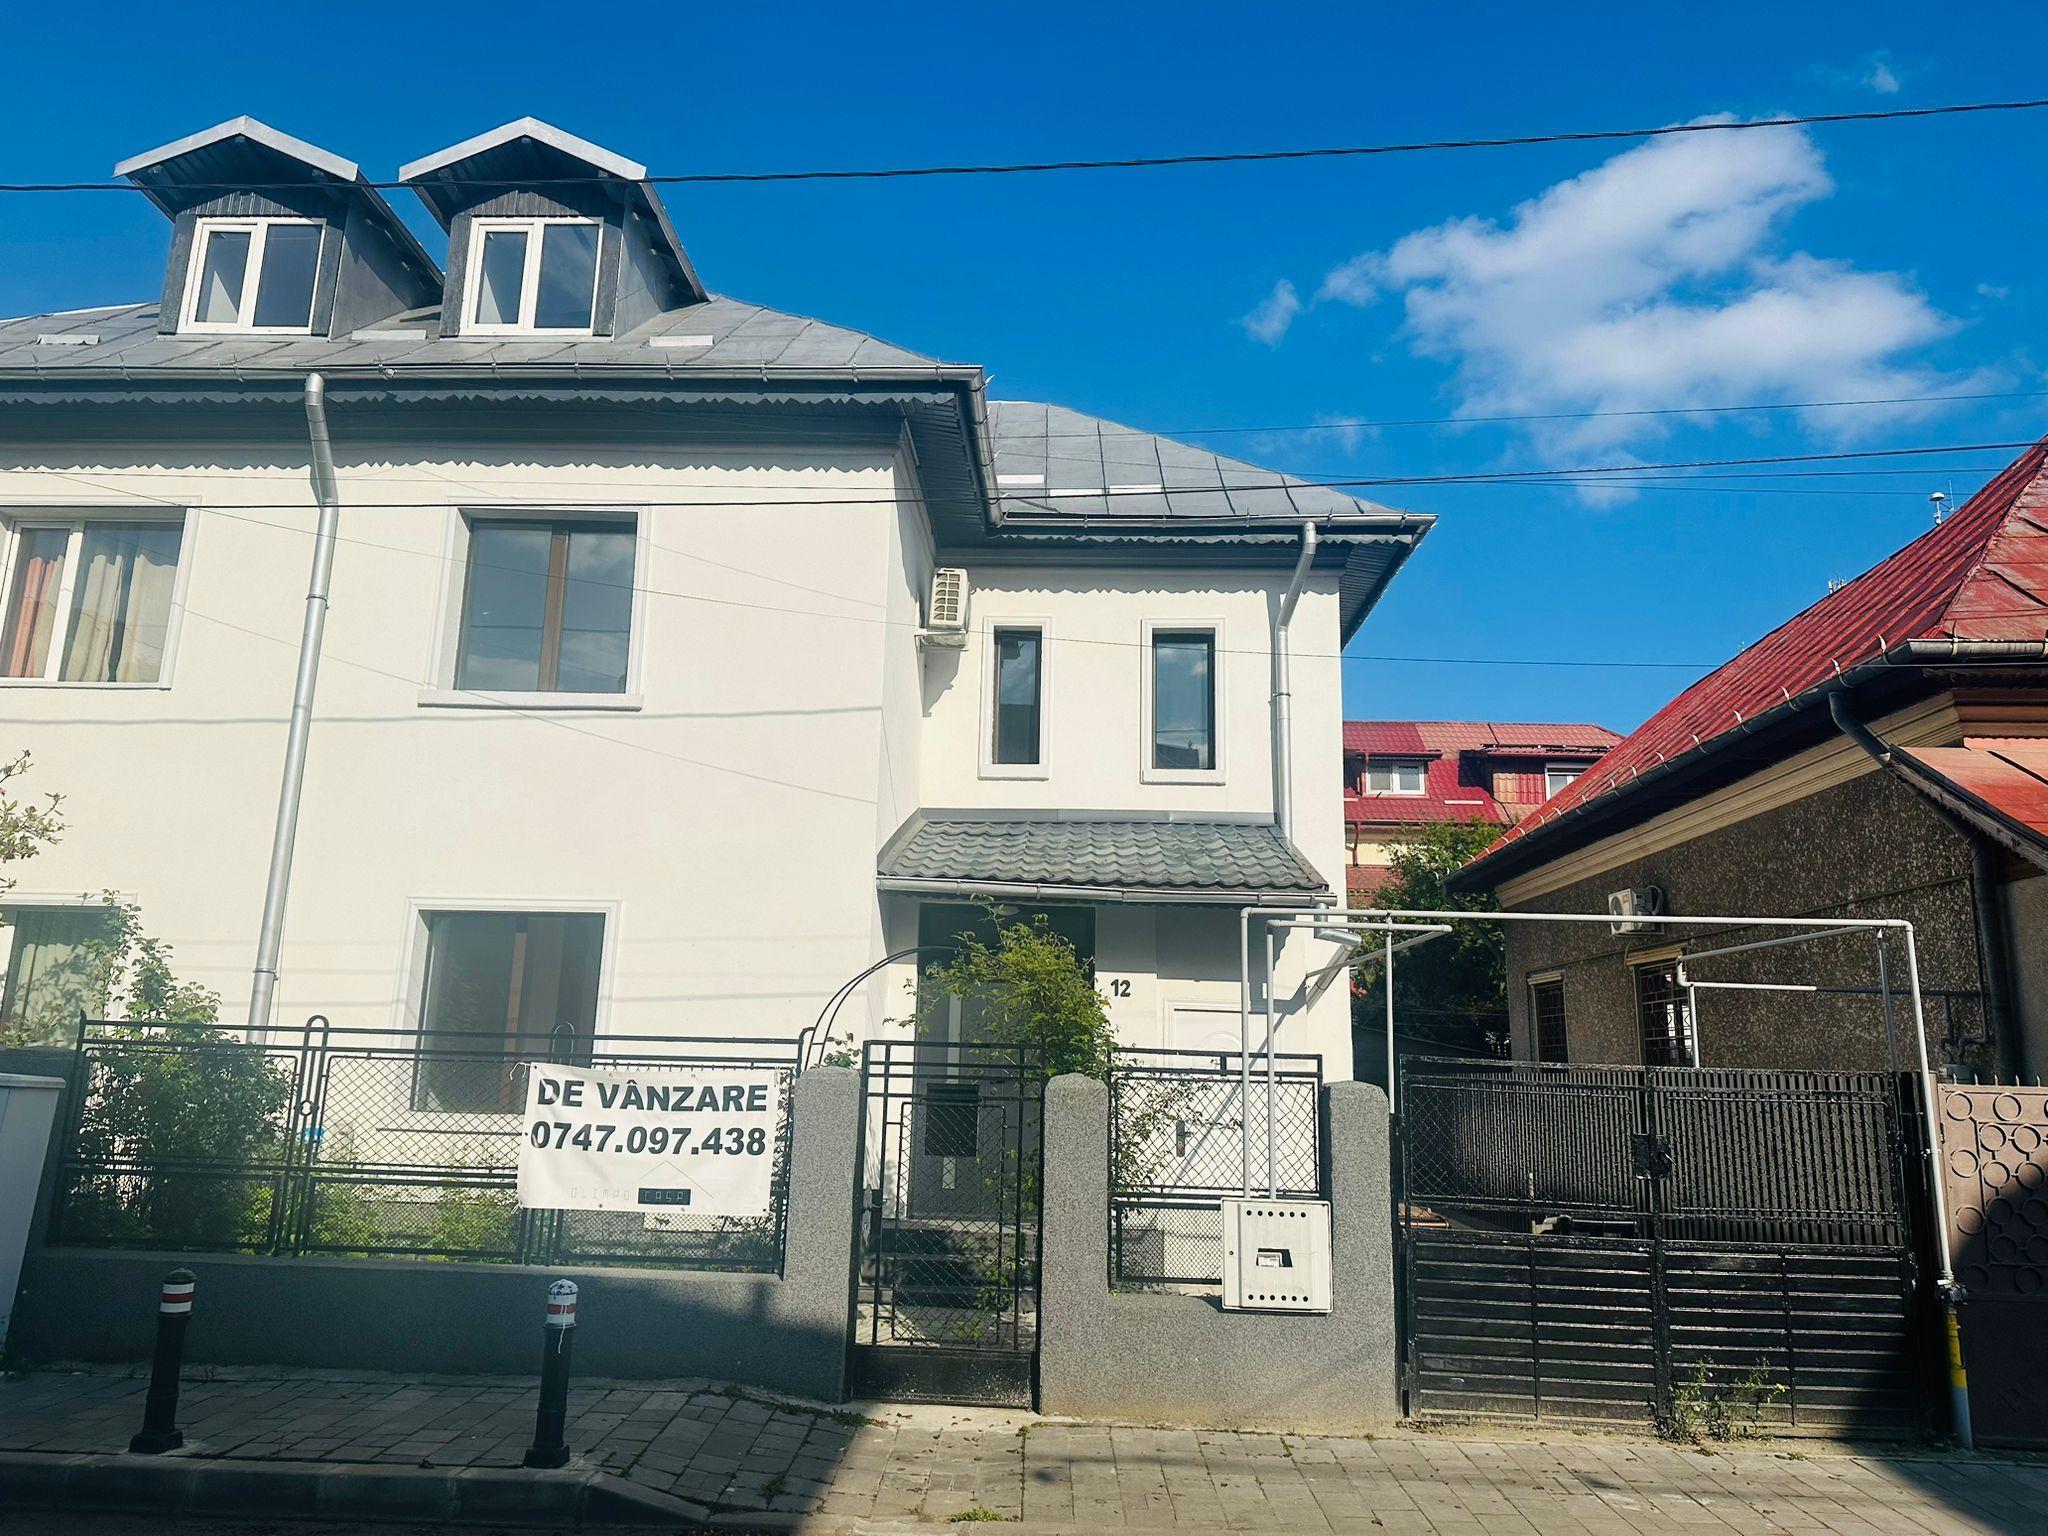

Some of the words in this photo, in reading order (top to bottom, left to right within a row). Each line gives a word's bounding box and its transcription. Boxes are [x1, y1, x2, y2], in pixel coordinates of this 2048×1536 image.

[1110, 978, 1131, 998] 12
[537, 1078, 585, 1108] DE
[596, 1079, 768, 1112] VÂNZARE
[530, 1120, 767, 1156] 0747.097.438
